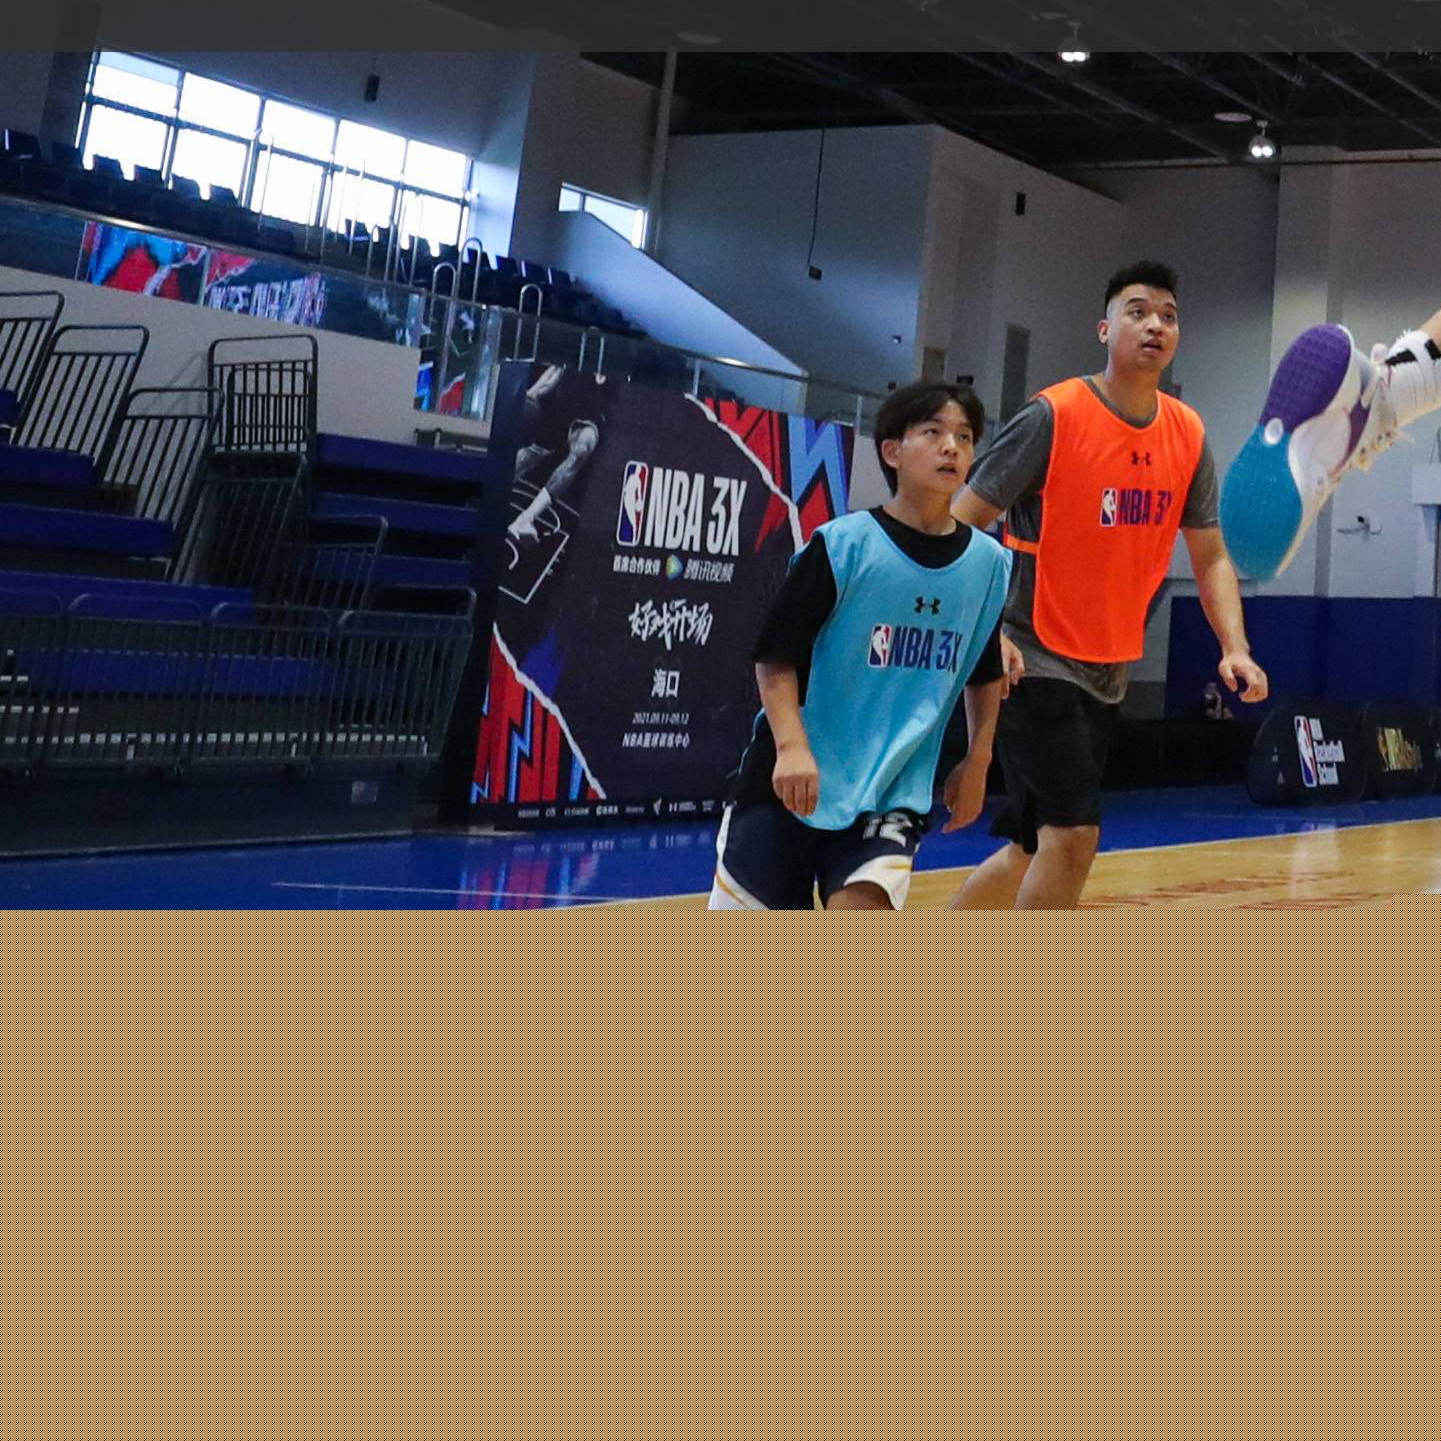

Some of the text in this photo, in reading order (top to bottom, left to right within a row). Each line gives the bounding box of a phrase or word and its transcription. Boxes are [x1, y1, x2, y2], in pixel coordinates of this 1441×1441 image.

[643, 466, 748, 557] NBA 3X
[1119, 488, 1173, 526] NBA 3
[891, 625, 932, 671] NBA
[651, 668, 681, 698] 海口
